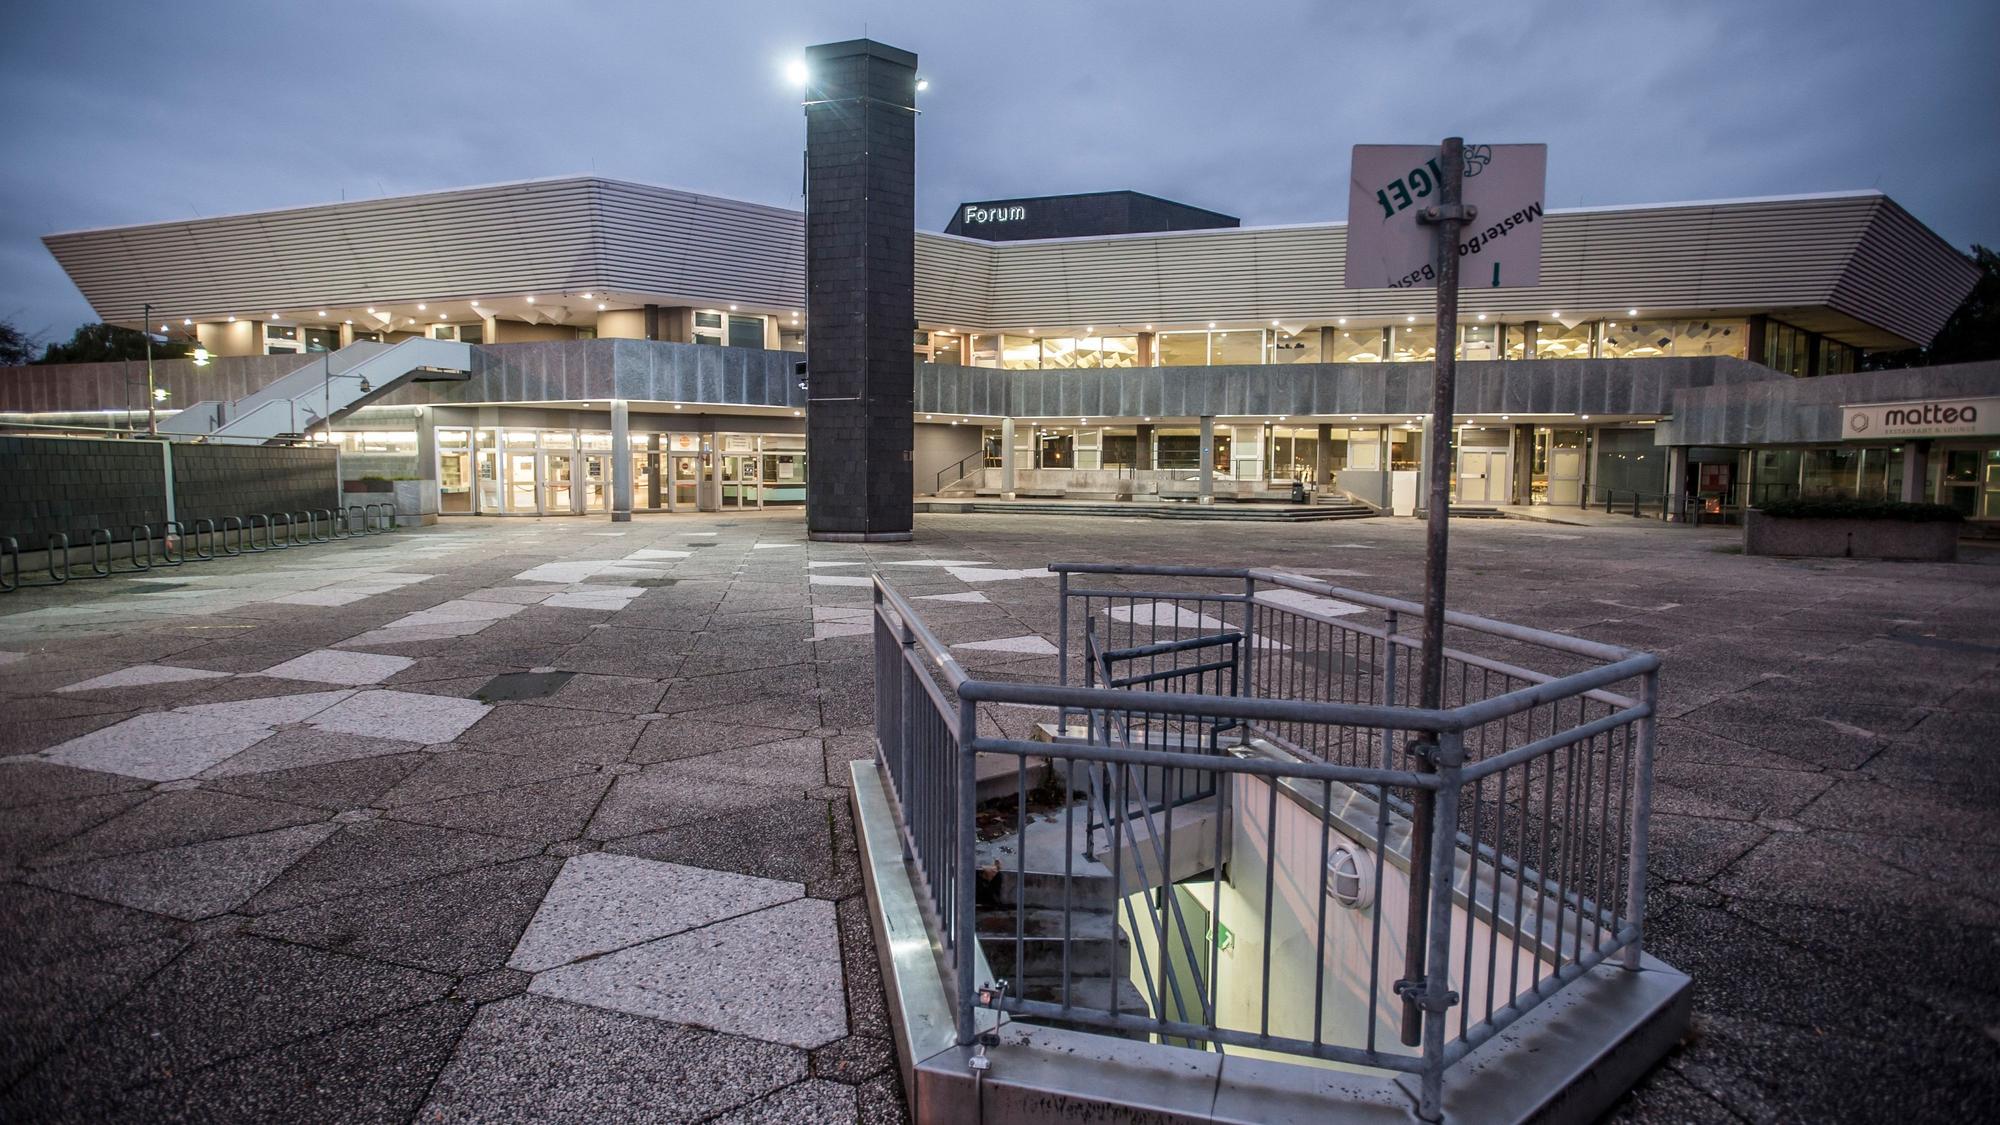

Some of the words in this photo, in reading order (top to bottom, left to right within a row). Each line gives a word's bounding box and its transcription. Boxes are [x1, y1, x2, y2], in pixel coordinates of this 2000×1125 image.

[964, 205, 1025, 224] Forum
[1458, 201, 1544, 257] MasterBo
[1884, 404, 1977, 426] mattea
